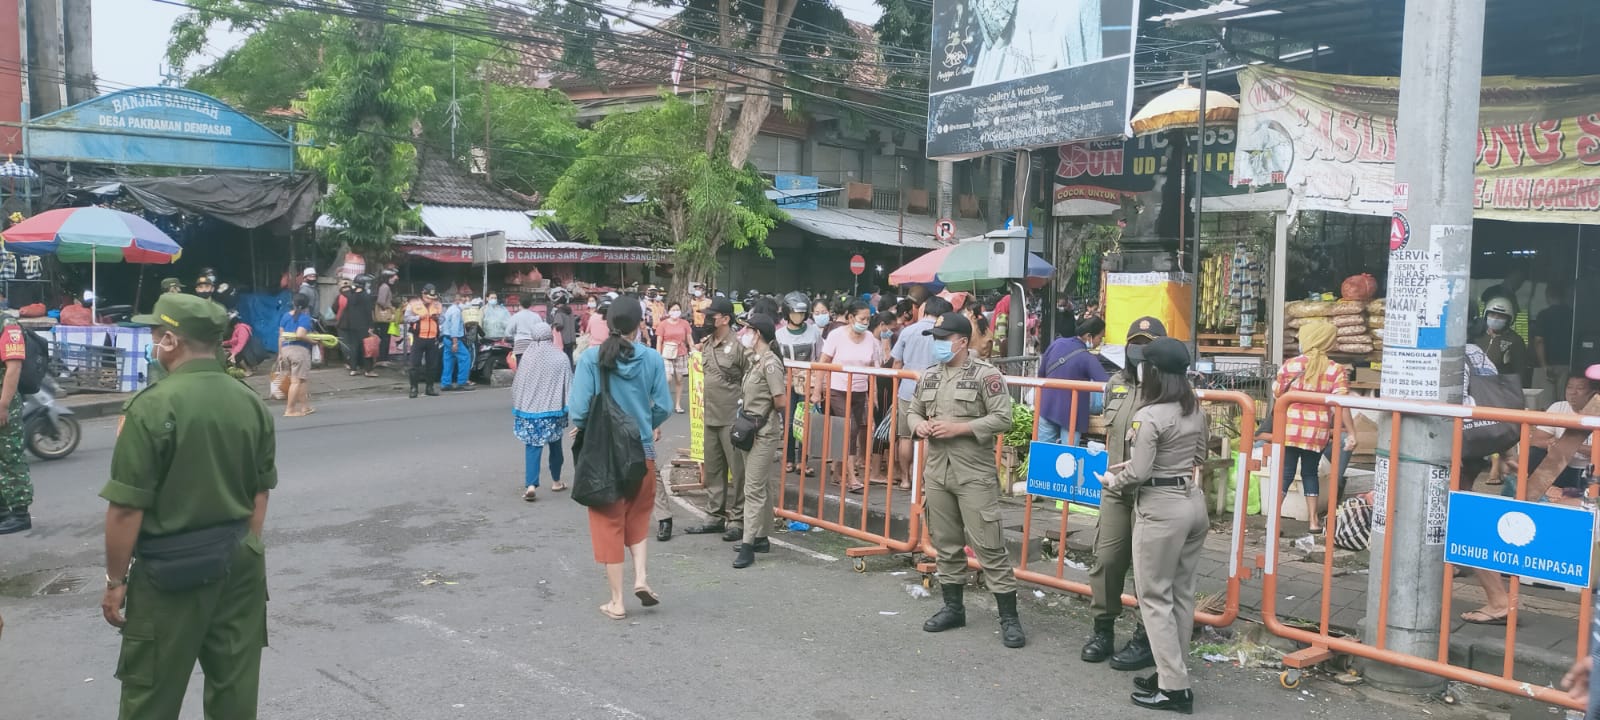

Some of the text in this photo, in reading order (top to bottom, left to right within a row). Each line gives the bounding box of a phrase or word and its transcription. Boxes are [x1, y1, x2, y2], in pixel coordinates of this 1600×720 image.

[990, 84, 1049, 102] Gallery & Workshop
[112, 94, 219, 120] BANJAR SANGLAH
[98, 115, 232, 136] DESA PAKRAMAN DENPASAR
[1133, 157, 1156, 175] UD
[1057, 189, 1117, 200] COCOK UNTUK
[1493, 178, 1532, 209] NASI
[1533, 177, 1600, 209] GORENG
[1029, 478, 1102, 499] DISHUB KOTA DENPASAR
[1450, 542, 1583, 577] DISHUB KOTA DENPASAR
